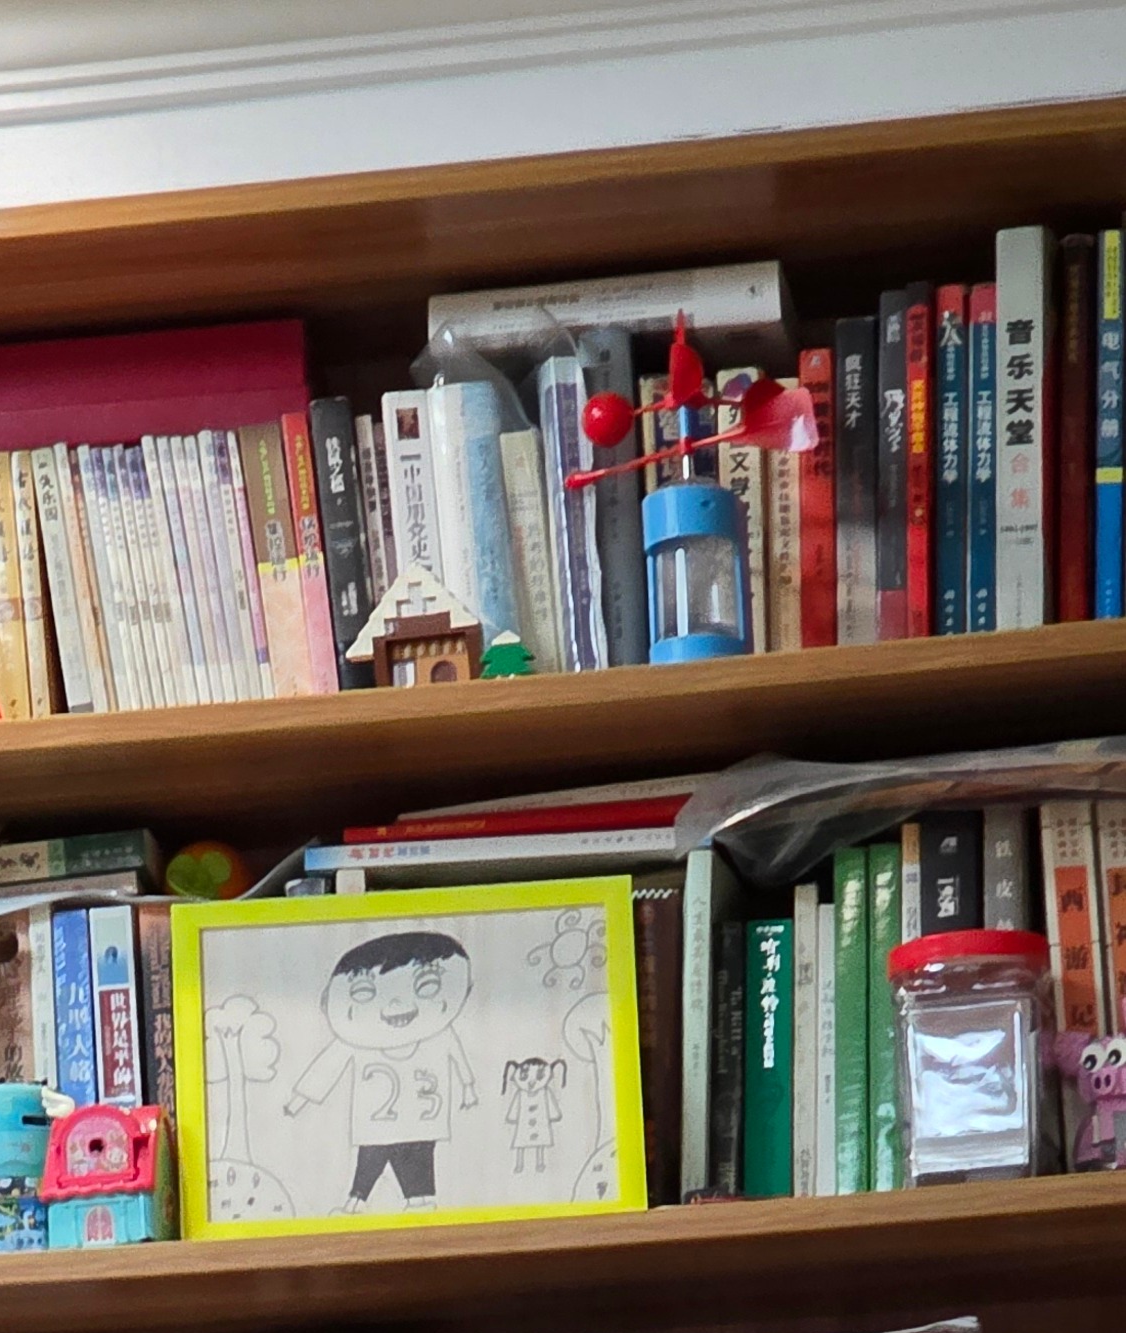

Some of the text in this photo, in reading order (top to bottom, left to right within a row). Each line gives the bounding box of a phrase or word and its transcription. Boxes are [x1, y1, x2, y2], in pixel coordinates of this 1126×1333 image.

[1006, 319, 1035, 446] 音乐天堂
[942, 391, 958, 483] 工程流体力学
[976, 390, 992, 483] 工程流体力学
[110, 991, 132, 1086] 世界是平的
